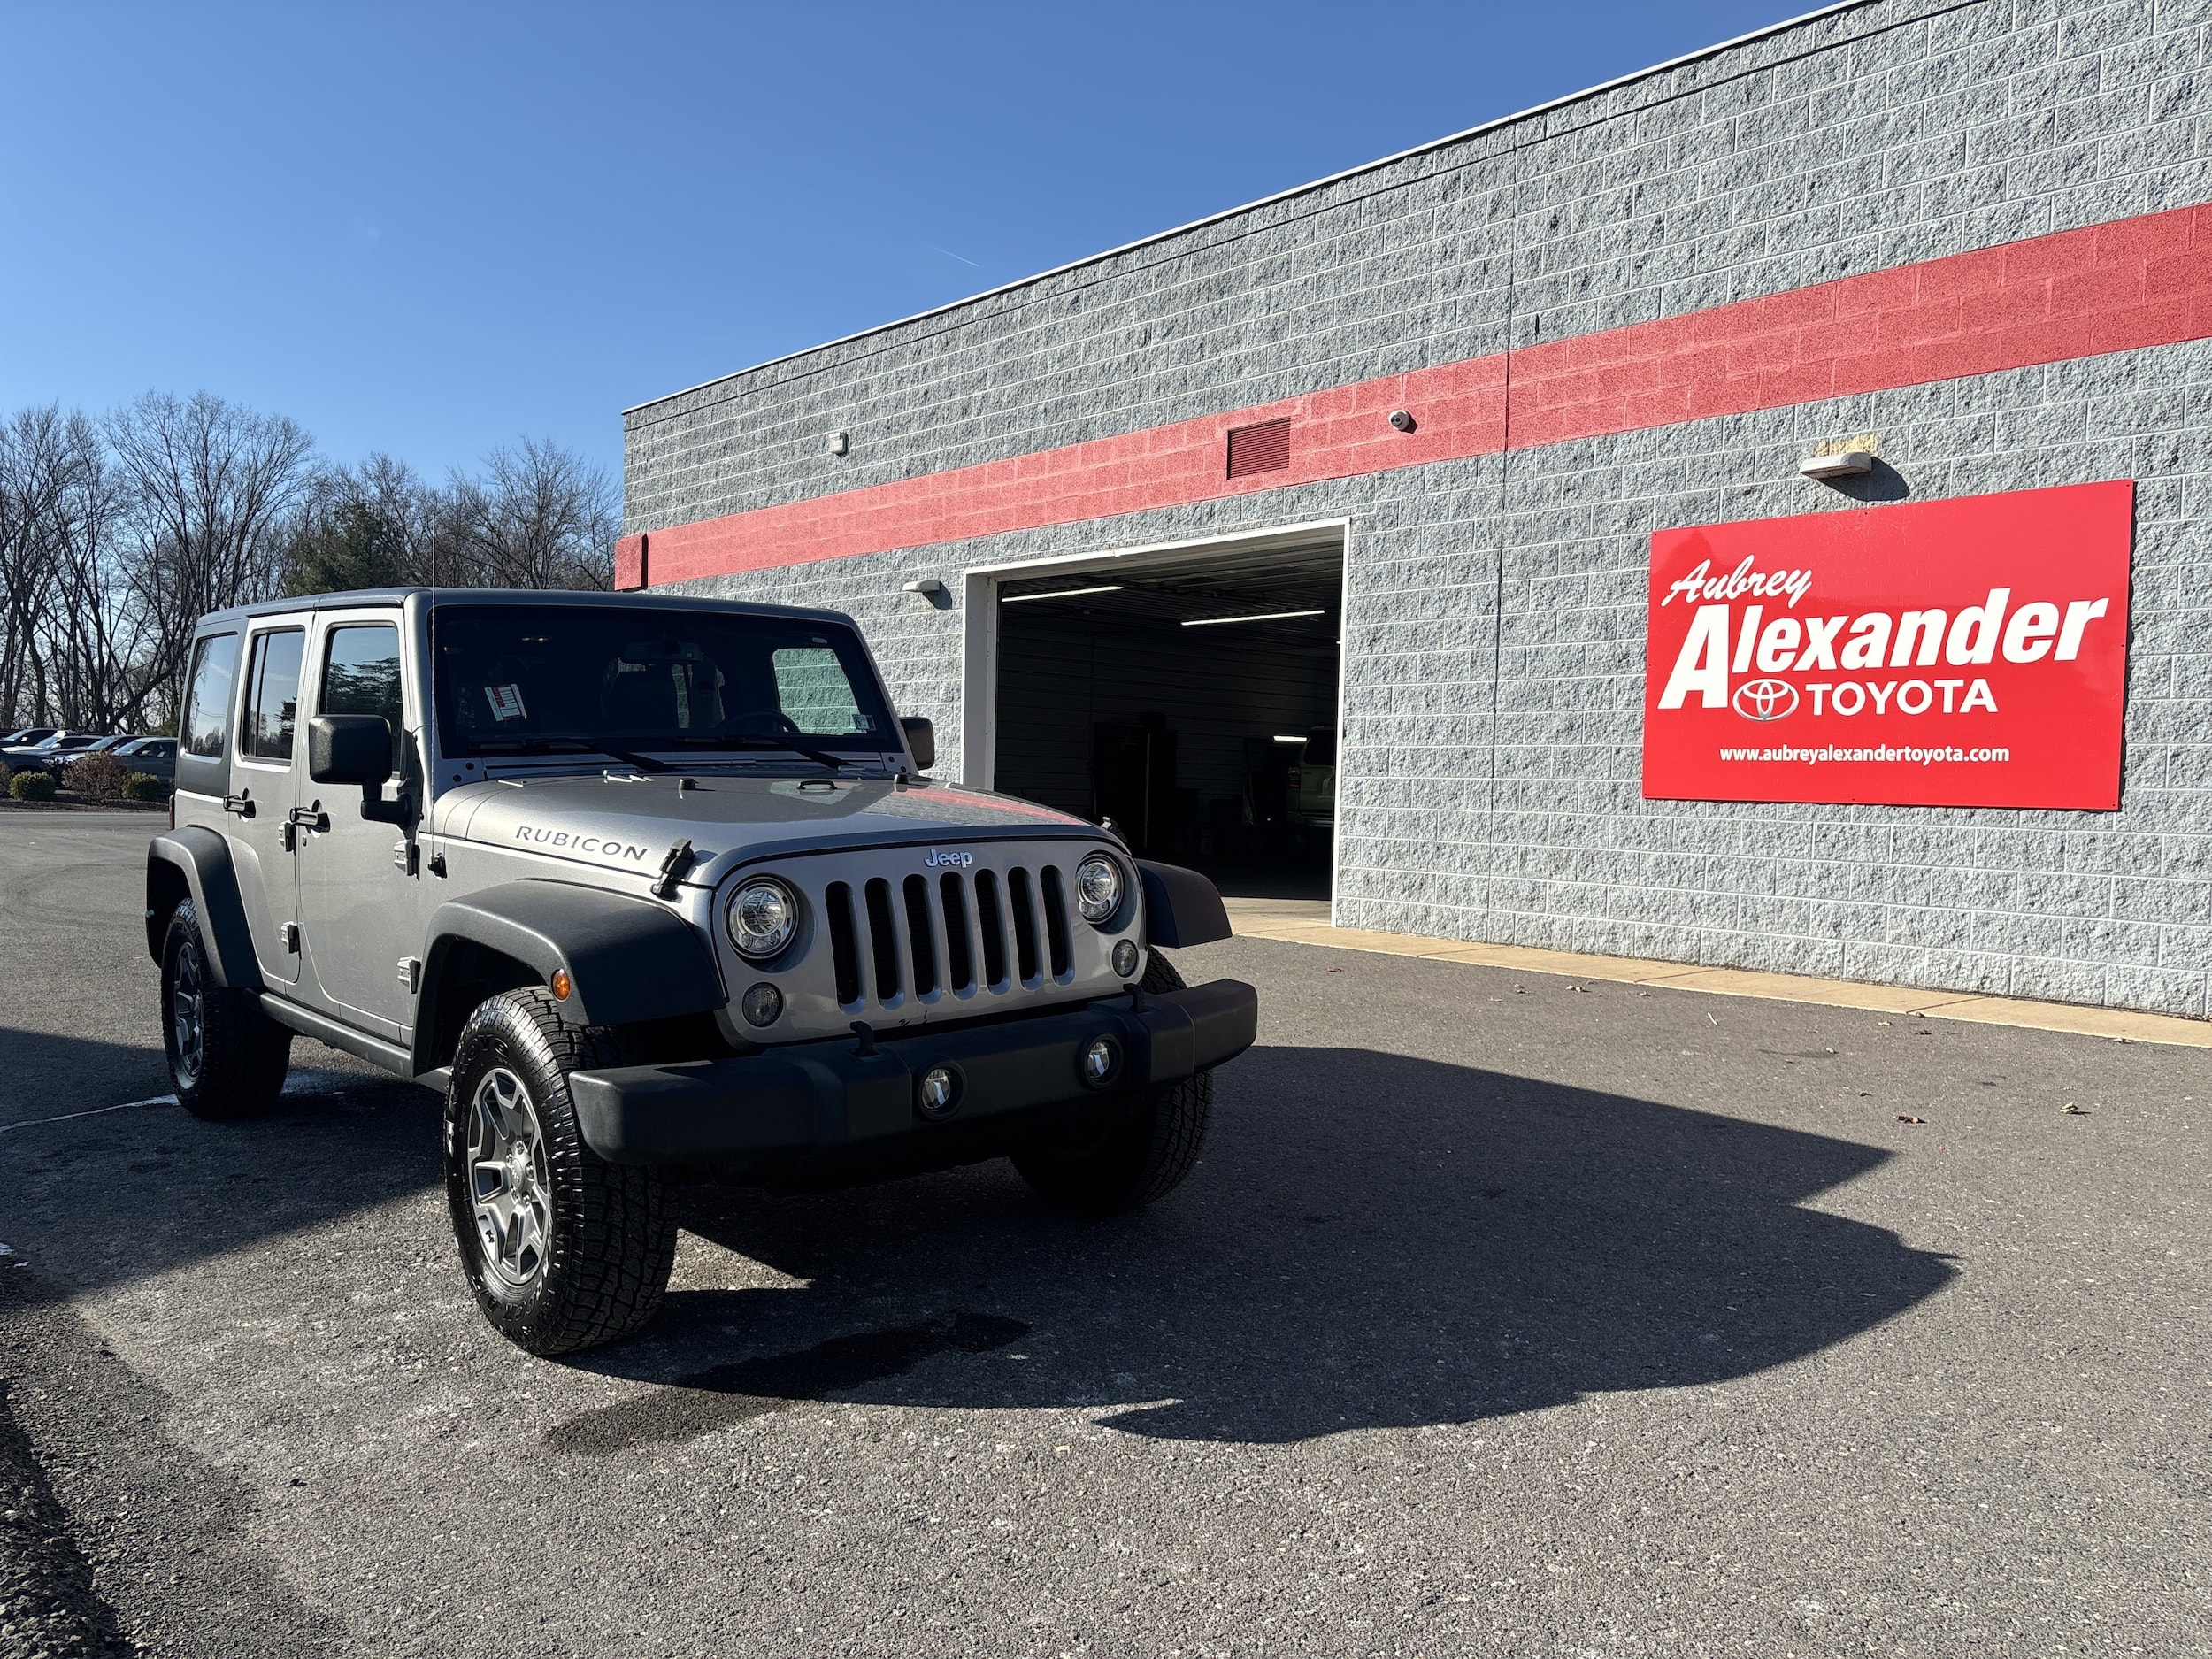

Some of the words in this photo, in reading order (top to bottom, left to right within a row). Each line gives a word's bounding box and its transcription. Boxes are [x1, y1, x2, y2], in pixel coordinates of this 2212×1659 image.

[1661, 554, 1812, 609] Aubrey
[1657, 587, 2110, 710] Alexander
[1805, 678, 1999, 717] TOYOTA
[1719, 743, 2010, 766] www.aubreyalexandertoyota.com
[515, 826, 648, 861] RUBICON
[924, 849, 972, 869] Jeep
